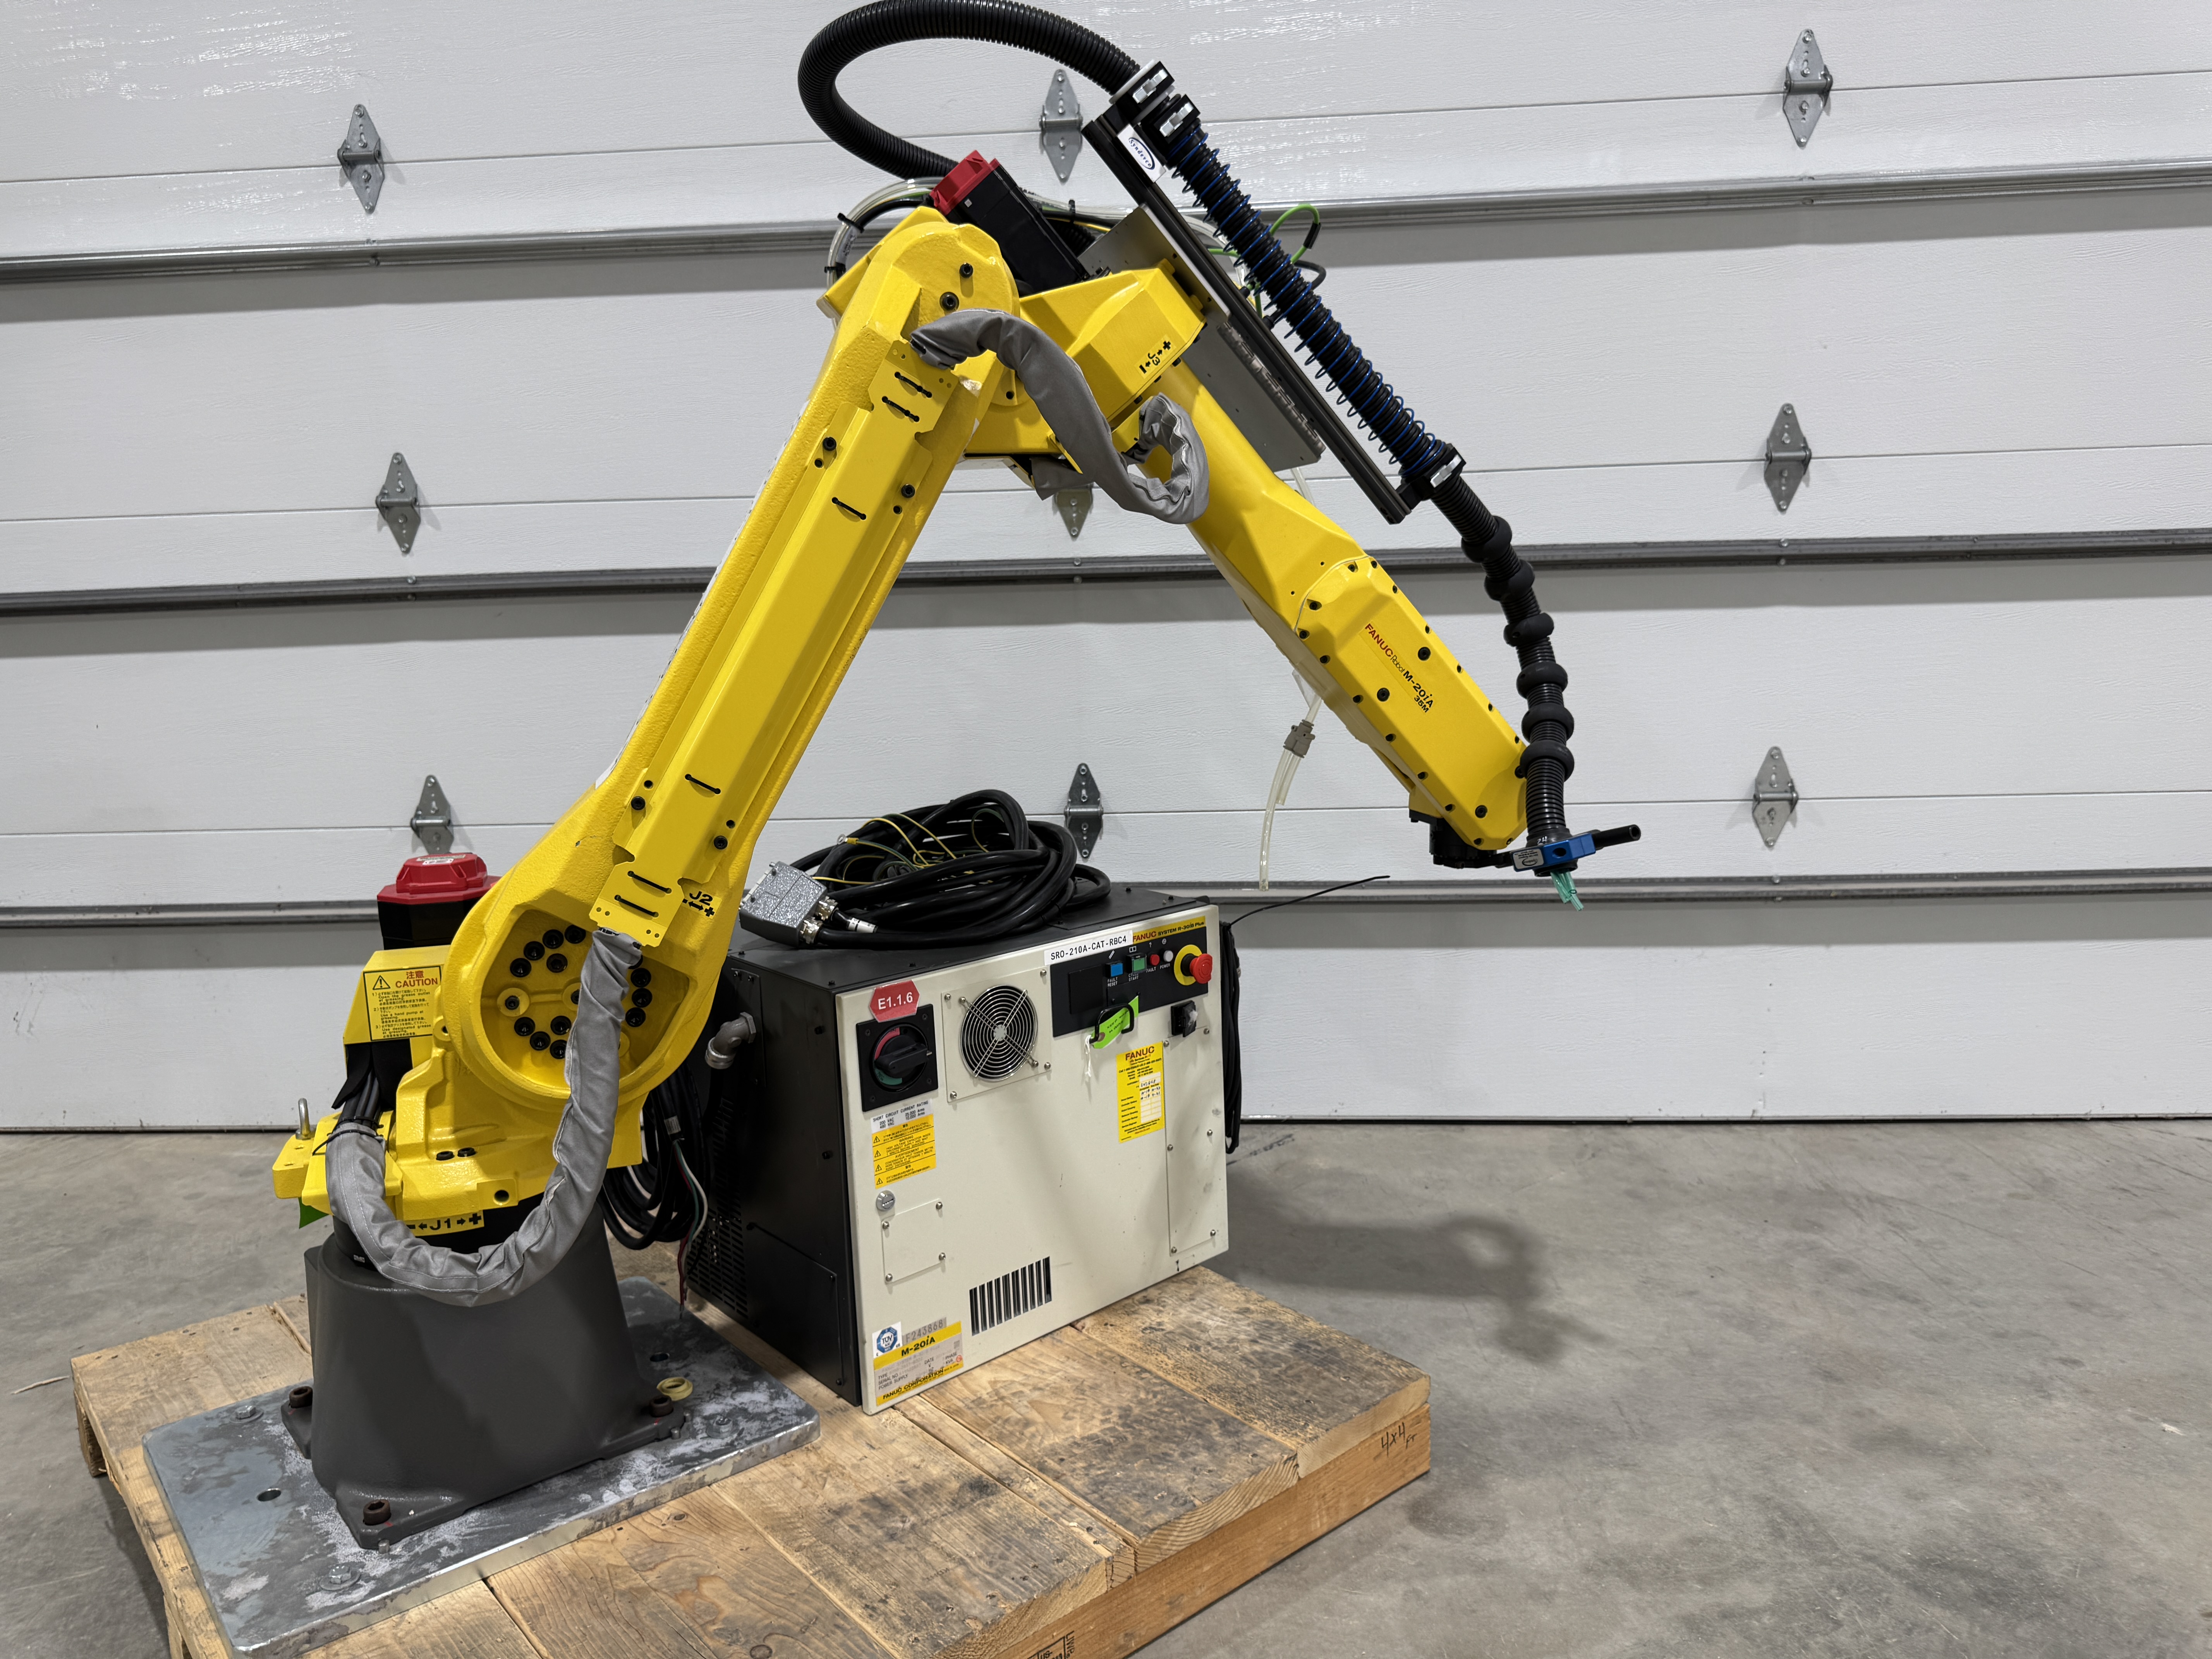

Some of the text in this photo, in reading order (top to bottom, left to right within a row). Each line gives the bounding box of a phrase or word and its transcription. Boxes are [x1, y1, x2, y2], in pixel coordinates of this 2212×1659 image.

[1129, 139, 1151, 167] Syndevco
[1148, 353, 1160, 366] J3
[1365, 623, 1433, 708] FANUC Robot M-20iA
[1414, 696, 1429, 713] 35M
[689, 891, 713, 906] J2
[1133, 931, 1156, 942] FANUC
[1158, 927, 1176, 936] SYSTEM
[1051, 935, 1127, 960] SRO-210A-CAT-RBC4
[395, 977, 438, 988] CAUTION
[878, 992, 913, 1010] E1.1.6
[1125, 1046, 1154, 1061] FANUC
[900, 1105, 915, 1113] CURRENT
[429, 1218, 451, 1230] J1
[907, 1319, 943, 1343] F243868
[902, 1335, 935, 1356] M-20iA
[878, 1376, 891, 1385] SERIAL
[879, 1381, 893, 1389] POWER
[894, 1374, 908, 1383] SUPPLY
[883, 1387, 902, 1399] FANUC
[904, 1368, 944, 1389] CORPORATION
